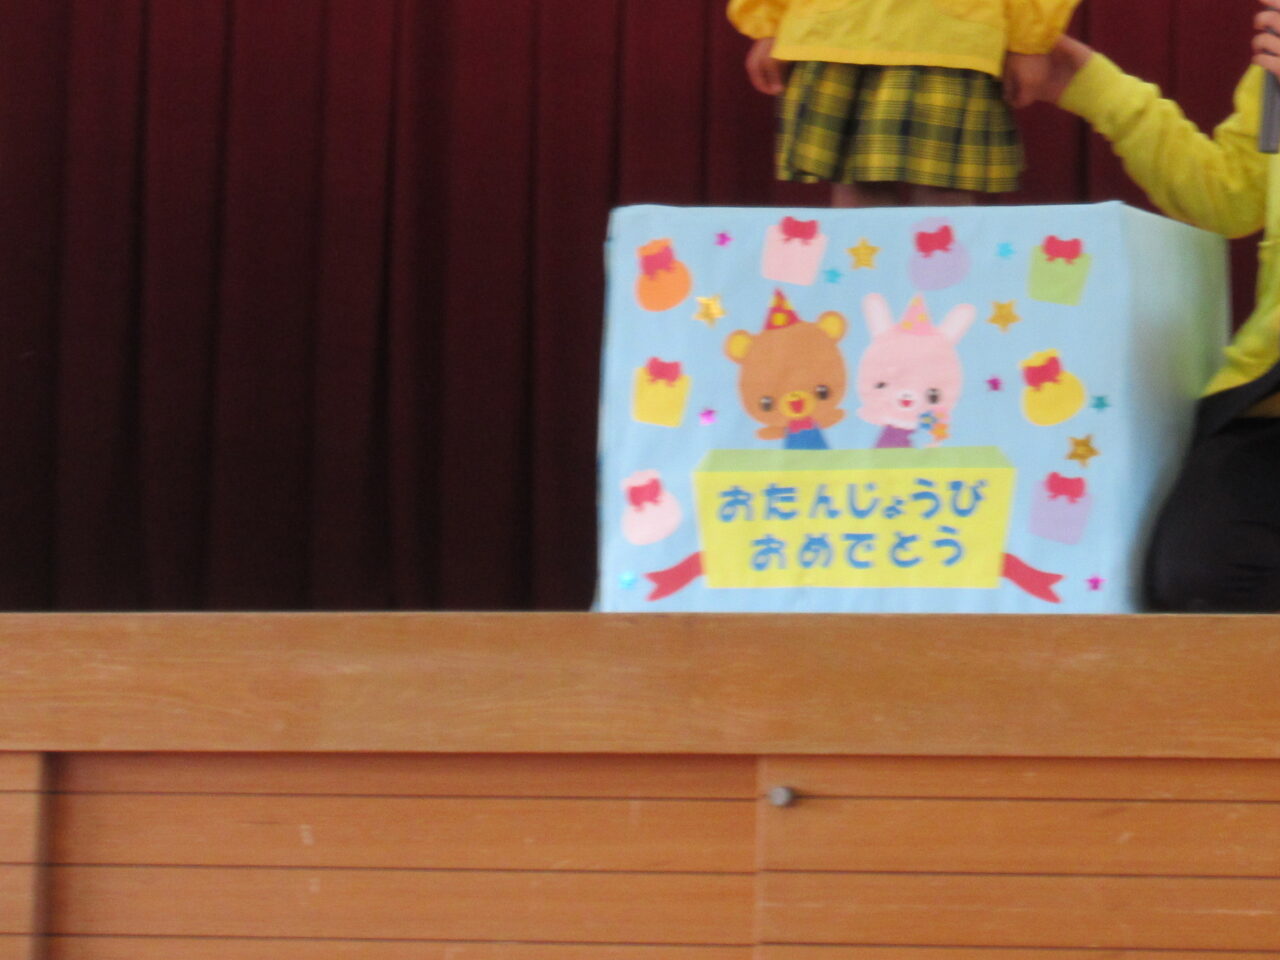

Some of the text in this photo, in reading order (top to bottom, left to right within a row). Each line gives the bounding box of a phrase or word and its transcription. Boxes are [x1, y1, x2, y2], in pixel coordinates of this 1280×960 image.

[718, 478, 988, 522] おたんじょうび
[751, 526, 966, 571] おめでとう
